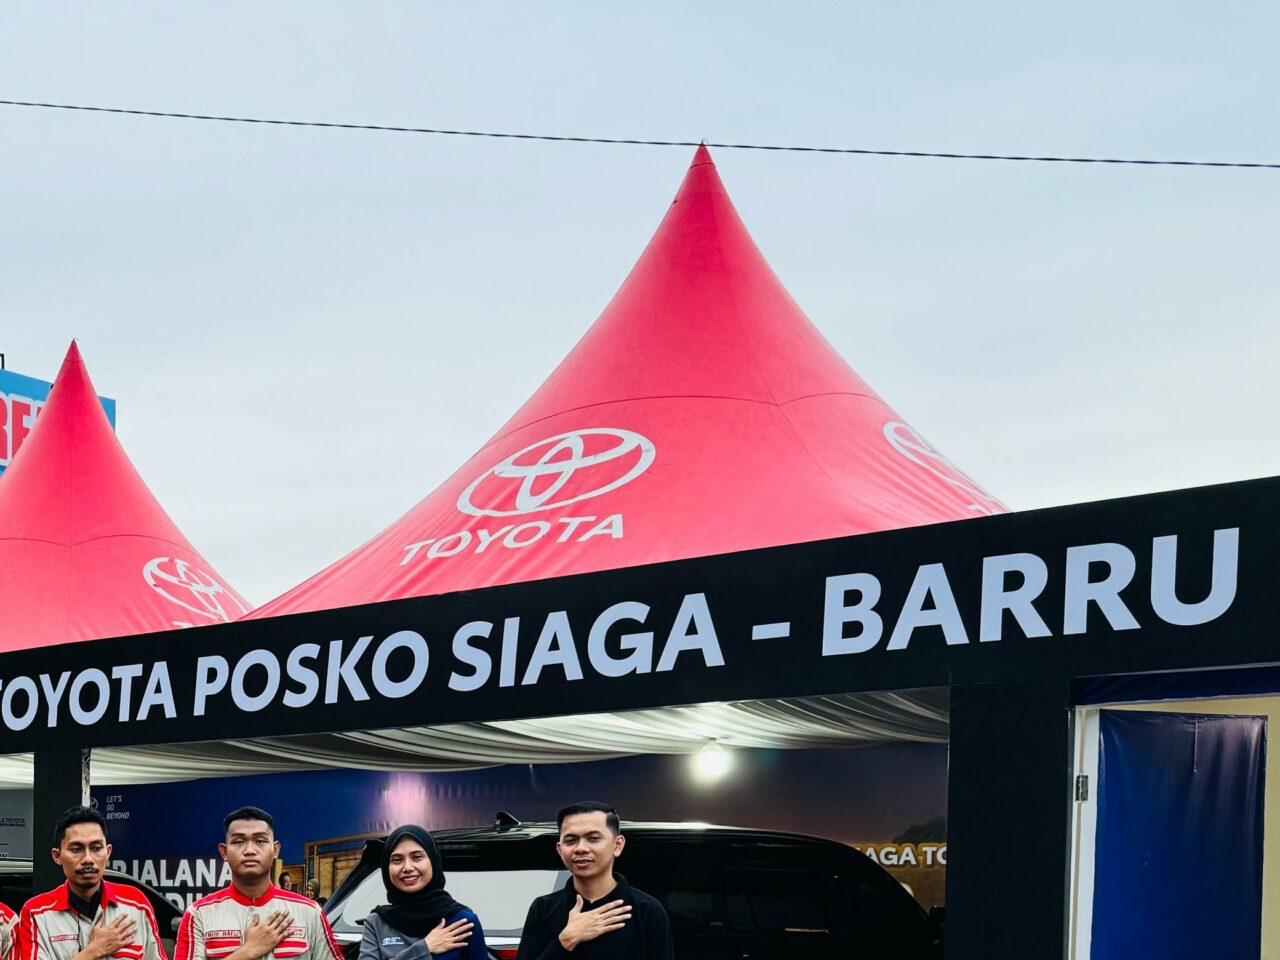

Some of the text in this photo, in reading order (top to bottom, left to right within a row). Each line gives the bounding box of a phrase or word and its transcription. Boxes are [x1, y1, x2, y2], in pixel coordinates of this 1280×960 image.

[399, 513, 625, 567] TOYOTA
[193, 630, 430, 717] POSKO
[447, 592, 725, 694] SIAGA
[821, 527, 1241, 657] BARRU
